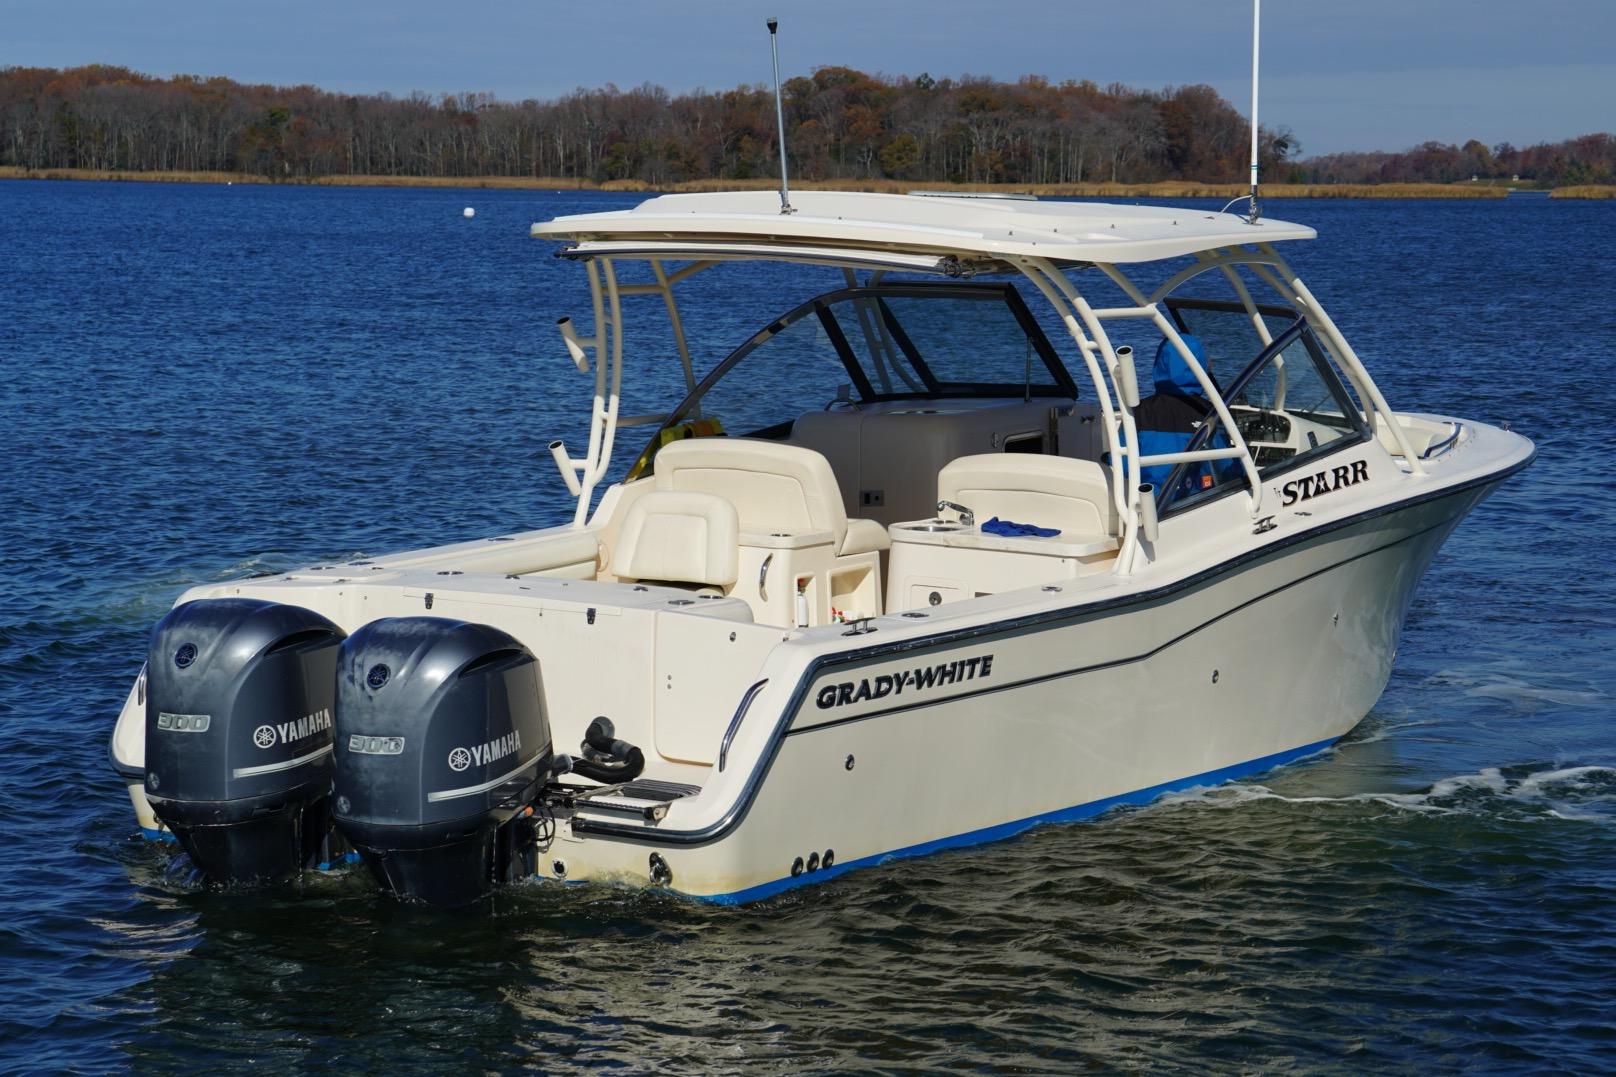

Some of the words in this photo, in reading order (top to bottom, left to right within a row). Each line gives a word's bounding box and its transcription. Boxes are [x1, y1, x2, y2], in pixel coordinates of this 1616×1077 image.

[1282, 460, 1370, 508] STARR
[816, 654, 994, 709] GRADY-WHITE
[158, 713, 210, 731] 300
[276, 708, 331, 743] YAMAHA
[349, 735, 404, 754] 300
[470, 729, 521, 766] YAMAHA
